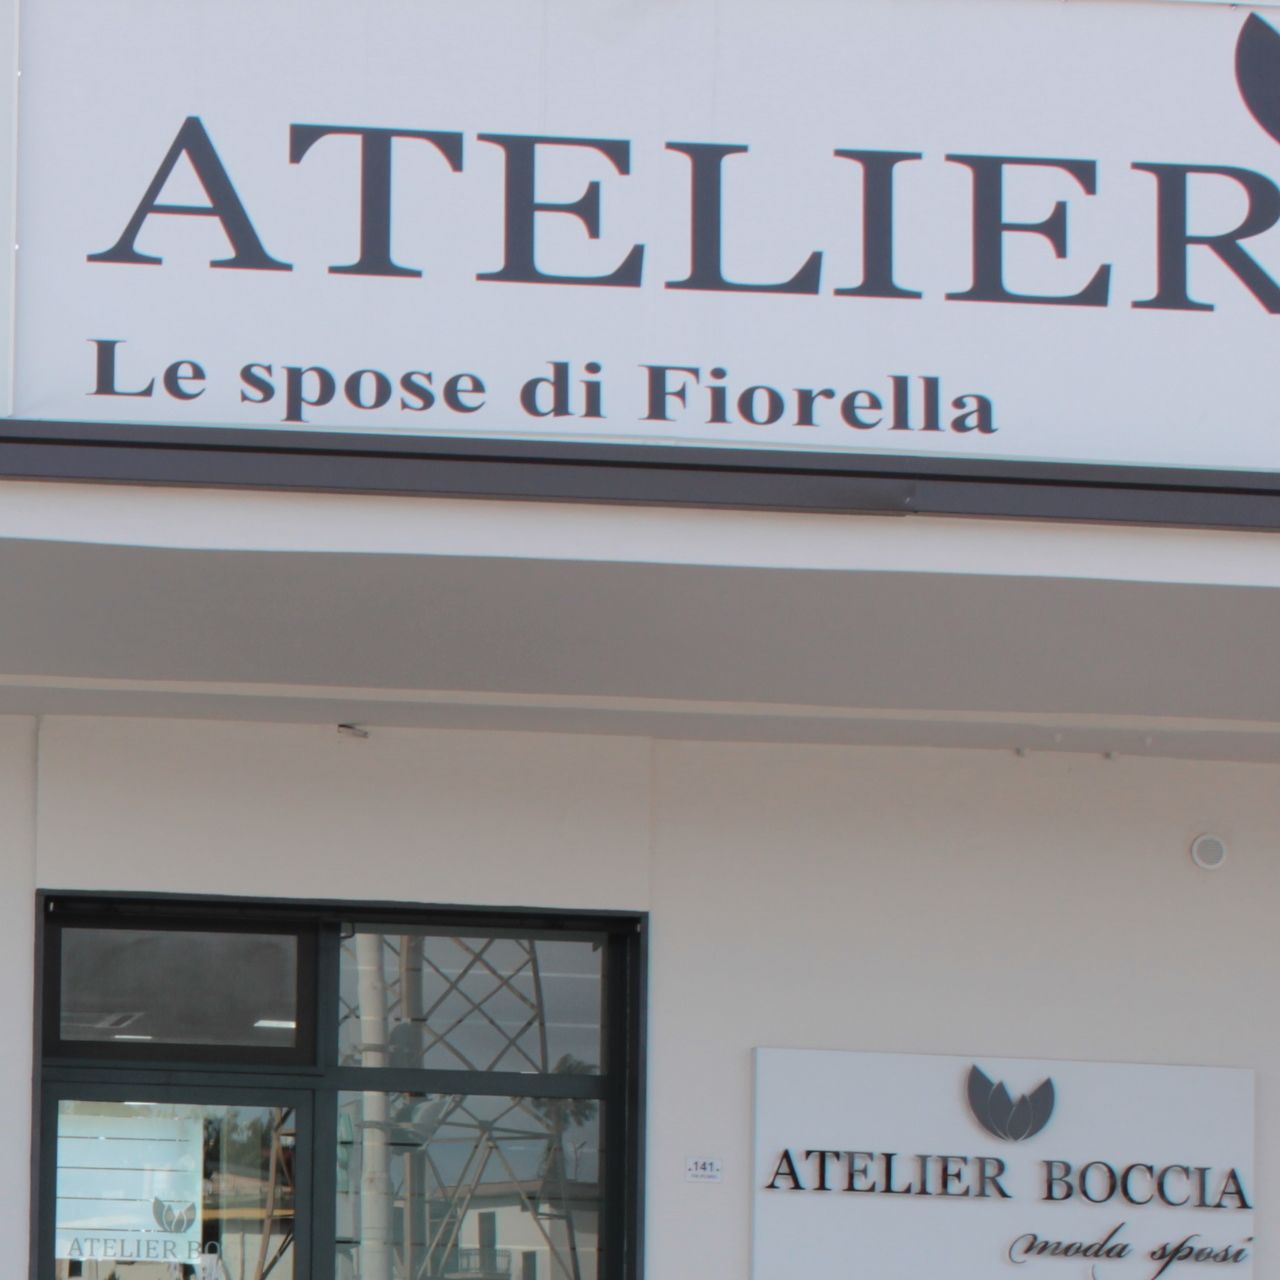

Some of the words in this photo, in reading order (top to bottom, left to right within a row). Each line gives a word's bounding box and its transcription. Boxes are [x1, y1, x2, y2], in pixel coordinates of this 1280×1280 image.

[86, 115, 1280, 314] ATELIER
[87, 338, 207, 401] Le
[240, 360, 487, 423] spose
[521, 360, 604, 419] di
[639, 364, 1000, 436] Fiorella
[765, 1148, 1012, 1199] ATELIER
[1041, 1159, 1253, 1210] BOCCIA
[68, 1237, 177, 1259] ATELIER
[1009, 1222, 1134, 1264] moda
